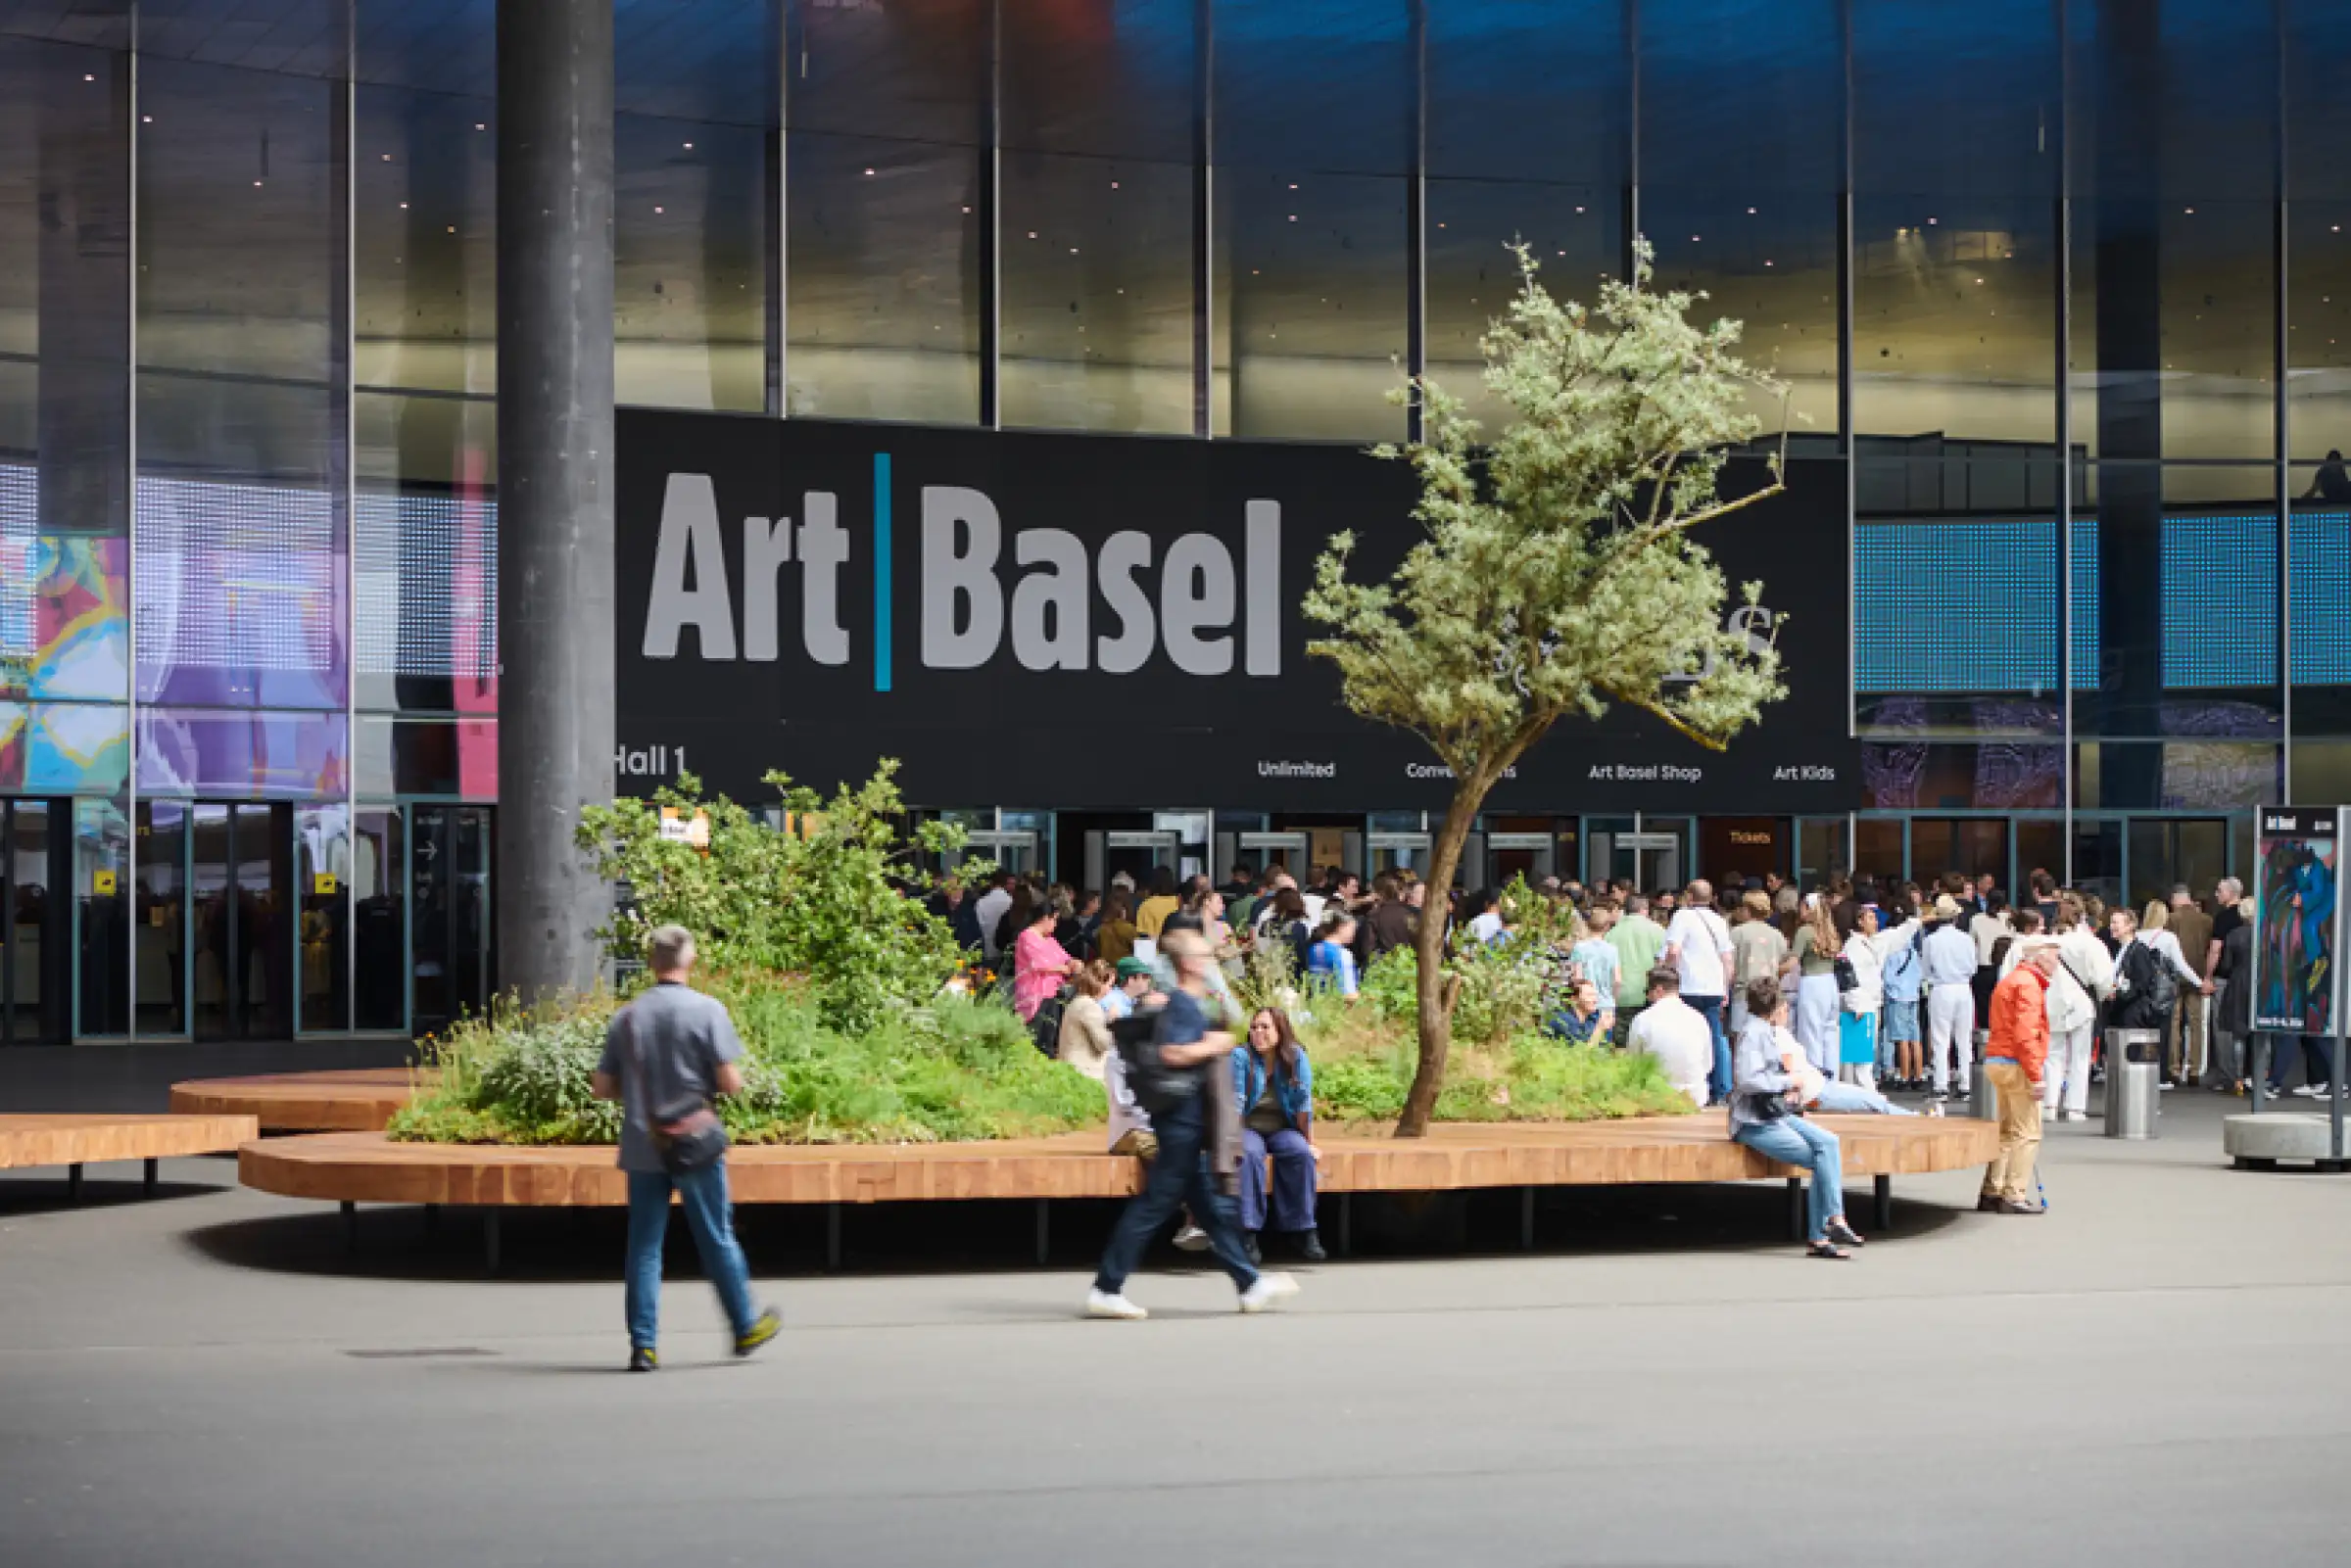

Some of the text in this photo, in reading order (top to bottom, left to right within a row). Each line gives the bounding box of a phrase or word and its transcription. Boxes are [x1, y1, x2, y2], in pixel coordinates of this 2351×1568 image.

[642, 472, 849, 665] Art
[921, 485, 1281, 677] Basel
[674, 745, 684, 775] 1
[1258, 760, 1336, 778] Unlimited
[1588, 764, 1703, 783] Art Basel Shop
[1773, 765, 1835, 781] Art Kids
